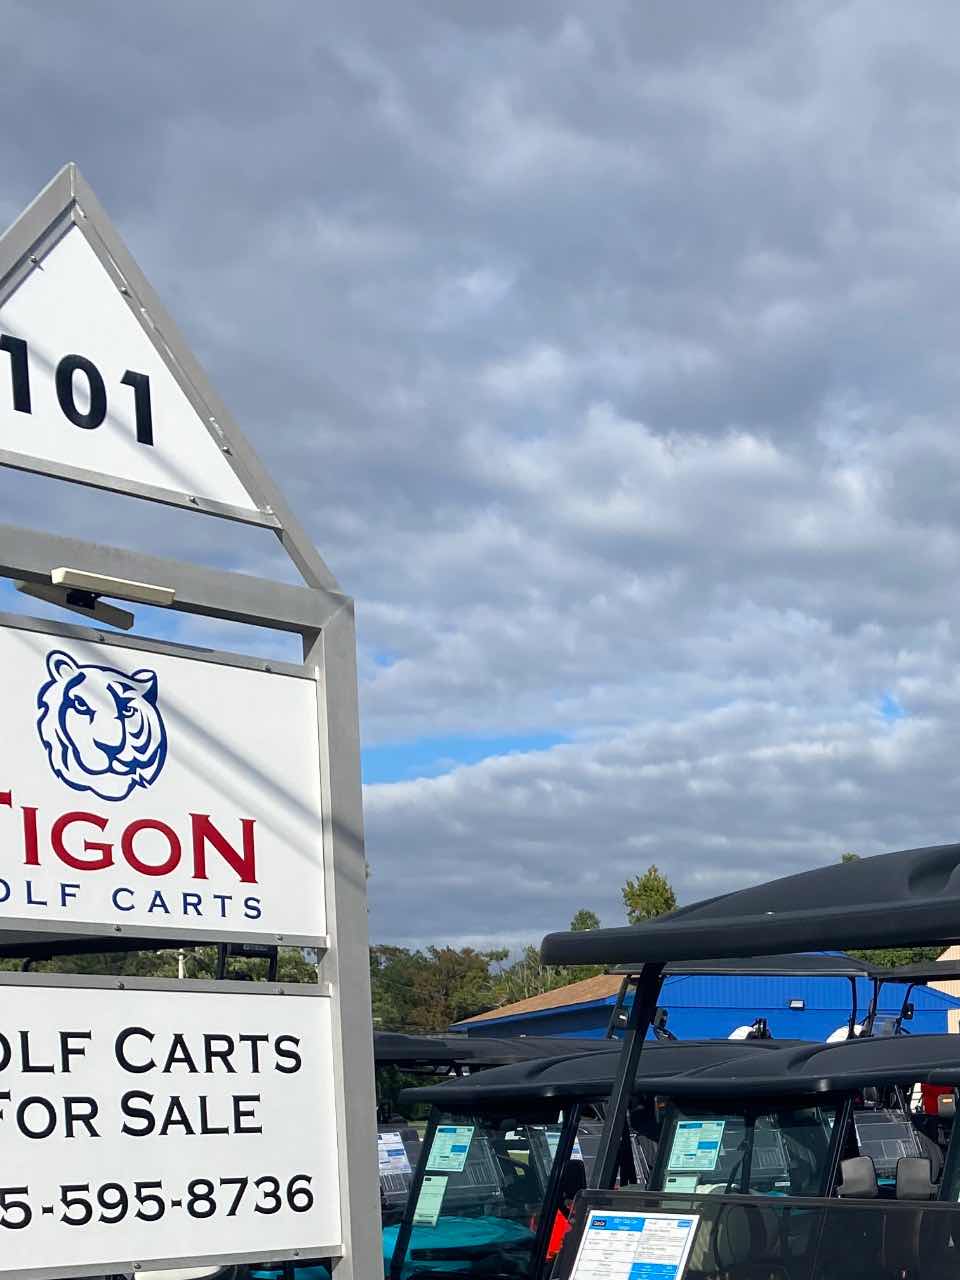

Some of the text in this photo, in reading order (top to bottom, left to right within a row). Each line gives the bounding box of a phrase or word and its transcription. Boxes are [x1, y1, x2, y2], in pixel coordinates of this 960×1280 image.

[0, 334, 154, 446] 101
[0, 789, 258, 884] IGON
[111, 887, 262, 919] CARTS
